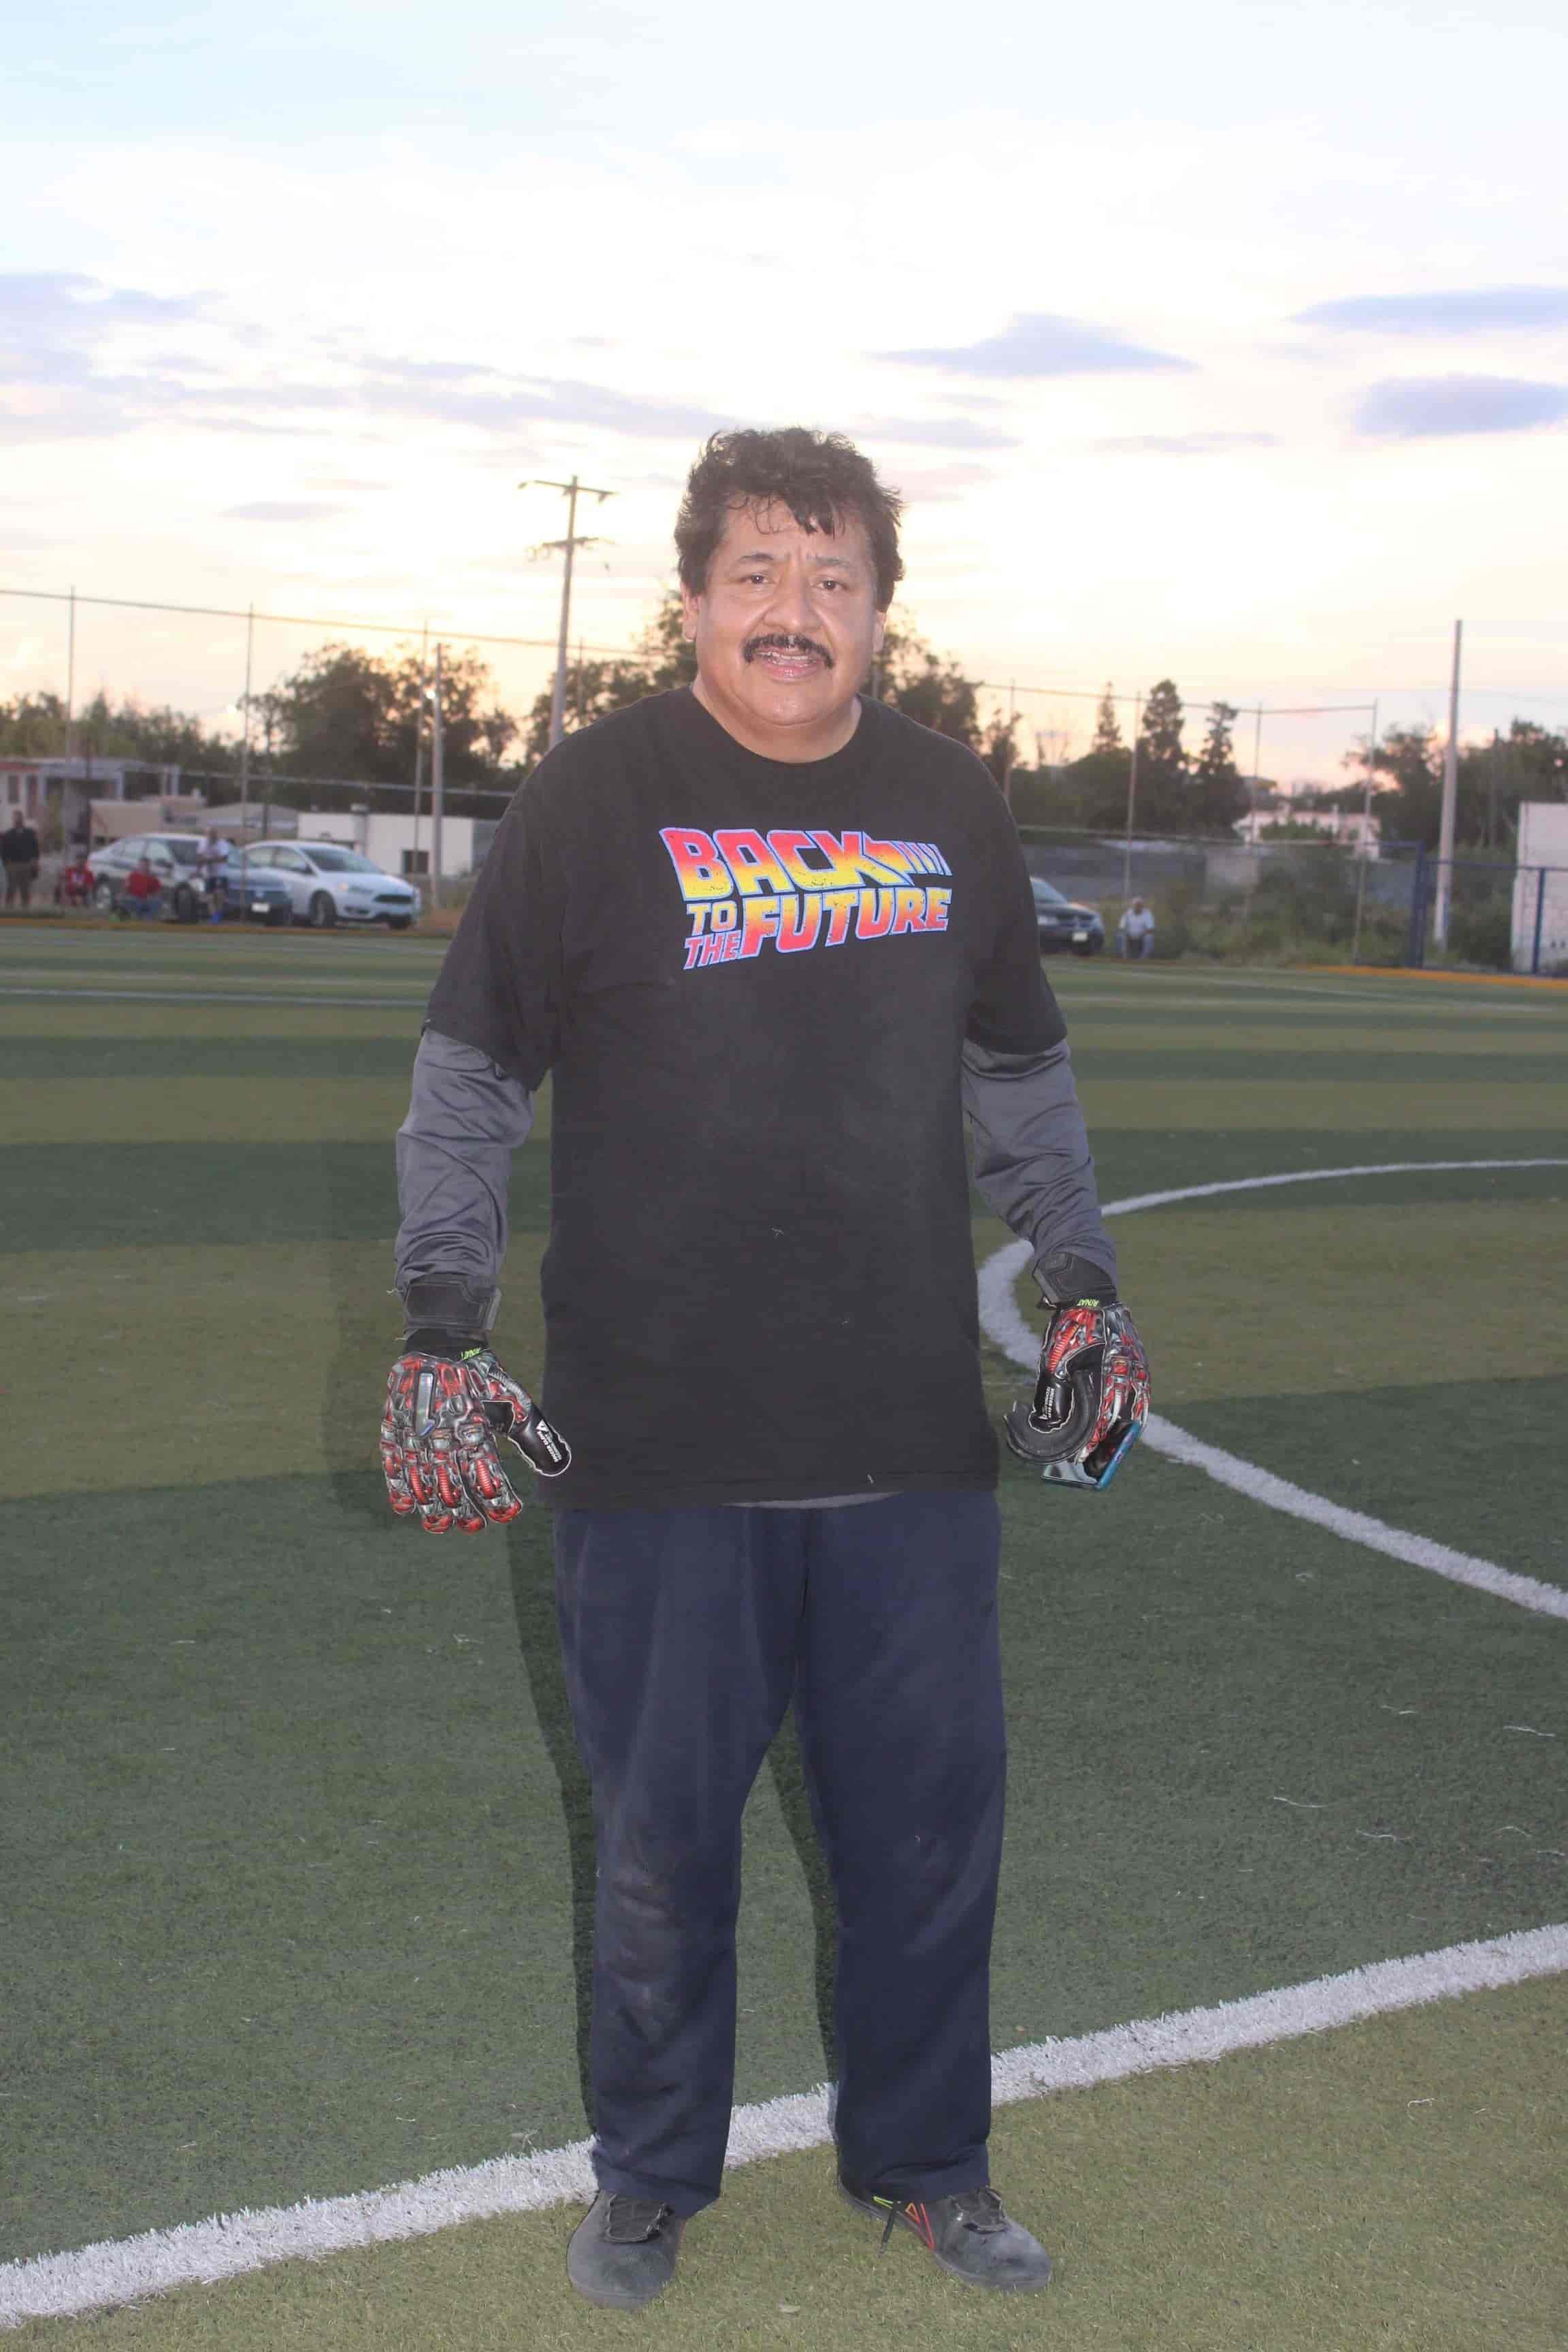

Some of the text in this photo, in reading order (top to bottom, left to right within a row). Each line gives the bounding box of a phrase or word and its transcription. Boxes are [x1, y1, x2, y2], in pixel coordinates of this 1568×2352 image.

[659, 828, 951, 902] BACK
[686, 900, 738, 936] TO
[739, 887, 953, 959] FUTURE
[683, 929, 742, 970] THE
